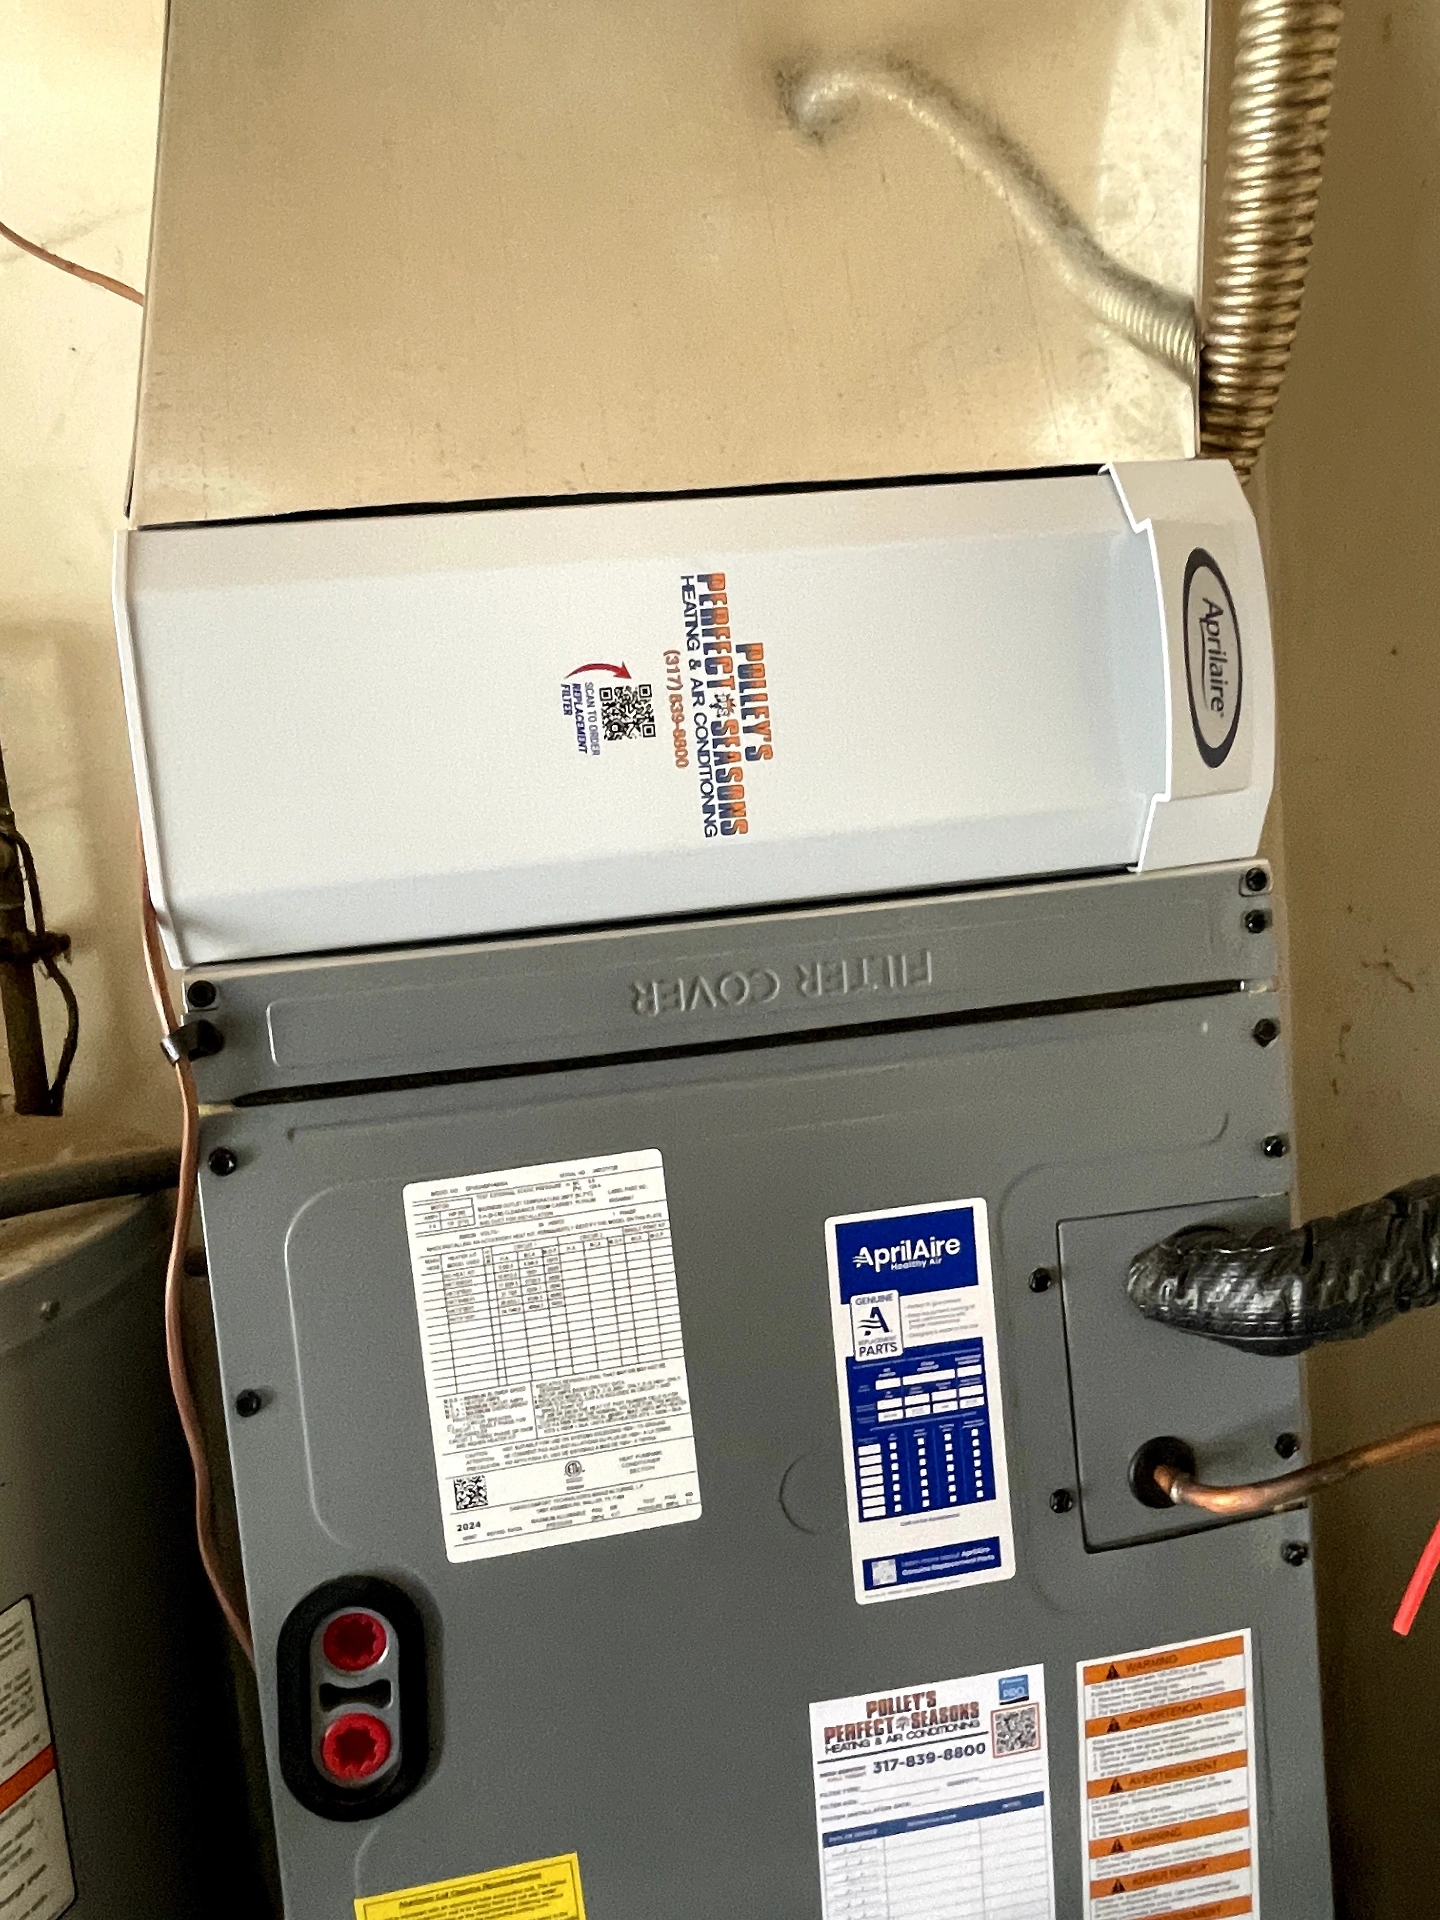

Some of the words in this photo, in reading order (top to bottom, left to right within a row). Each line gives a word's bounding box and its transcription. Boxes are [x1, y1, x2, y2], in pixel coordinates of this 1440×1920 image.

[680, 575, 700, 651] HEATING
[696, 572, 735, 690] PERFECT
[663, 650, 683, 691] (317)
[689, 658, 702, 671] &
[560, 683, 573, 716] FILTER
[584, 681, 596, 708] SCAN
[690, 677, 706, 707] AIR
[735, 642, 773, 761] POLLEY'S
[571, 683, 588, 754] REPLACEMENT
[587, 709, 597, 723] TO
[669, 694, 689, 769] 839-8800
[588, 724, 601, 756] ORDER
[694, 712, 718, 838] CONDITIONING
[710, 719, 748, 836] SEASONS
[630, 967, 782, 1017] COVER
[799, 950, 933, 998] FILTER
[852, 1236, 961, 1273] AprilAire
[890, 1259, 927, 1271] Healthy
[929, 1257, 943, 1266] Air
[855, 1293, 894, 1306] GENUINE
[859, 1342, 898, 1357] PARTS
[456, 1521, 481, 1532] 2024
[866, 1690, 937, 1718] POLLEY'S
[824, 1717, 894, 1744] PERFECT
[911, 1701, 979, 1729] SEASONS
[825, 1739, 871, 1755] HEATING
[886, 1733, 904, 1744] AIR
[906, 1719, 981, 1740] CONDITIONING
[873, 1743, 986, 1774] 317-839-8800
